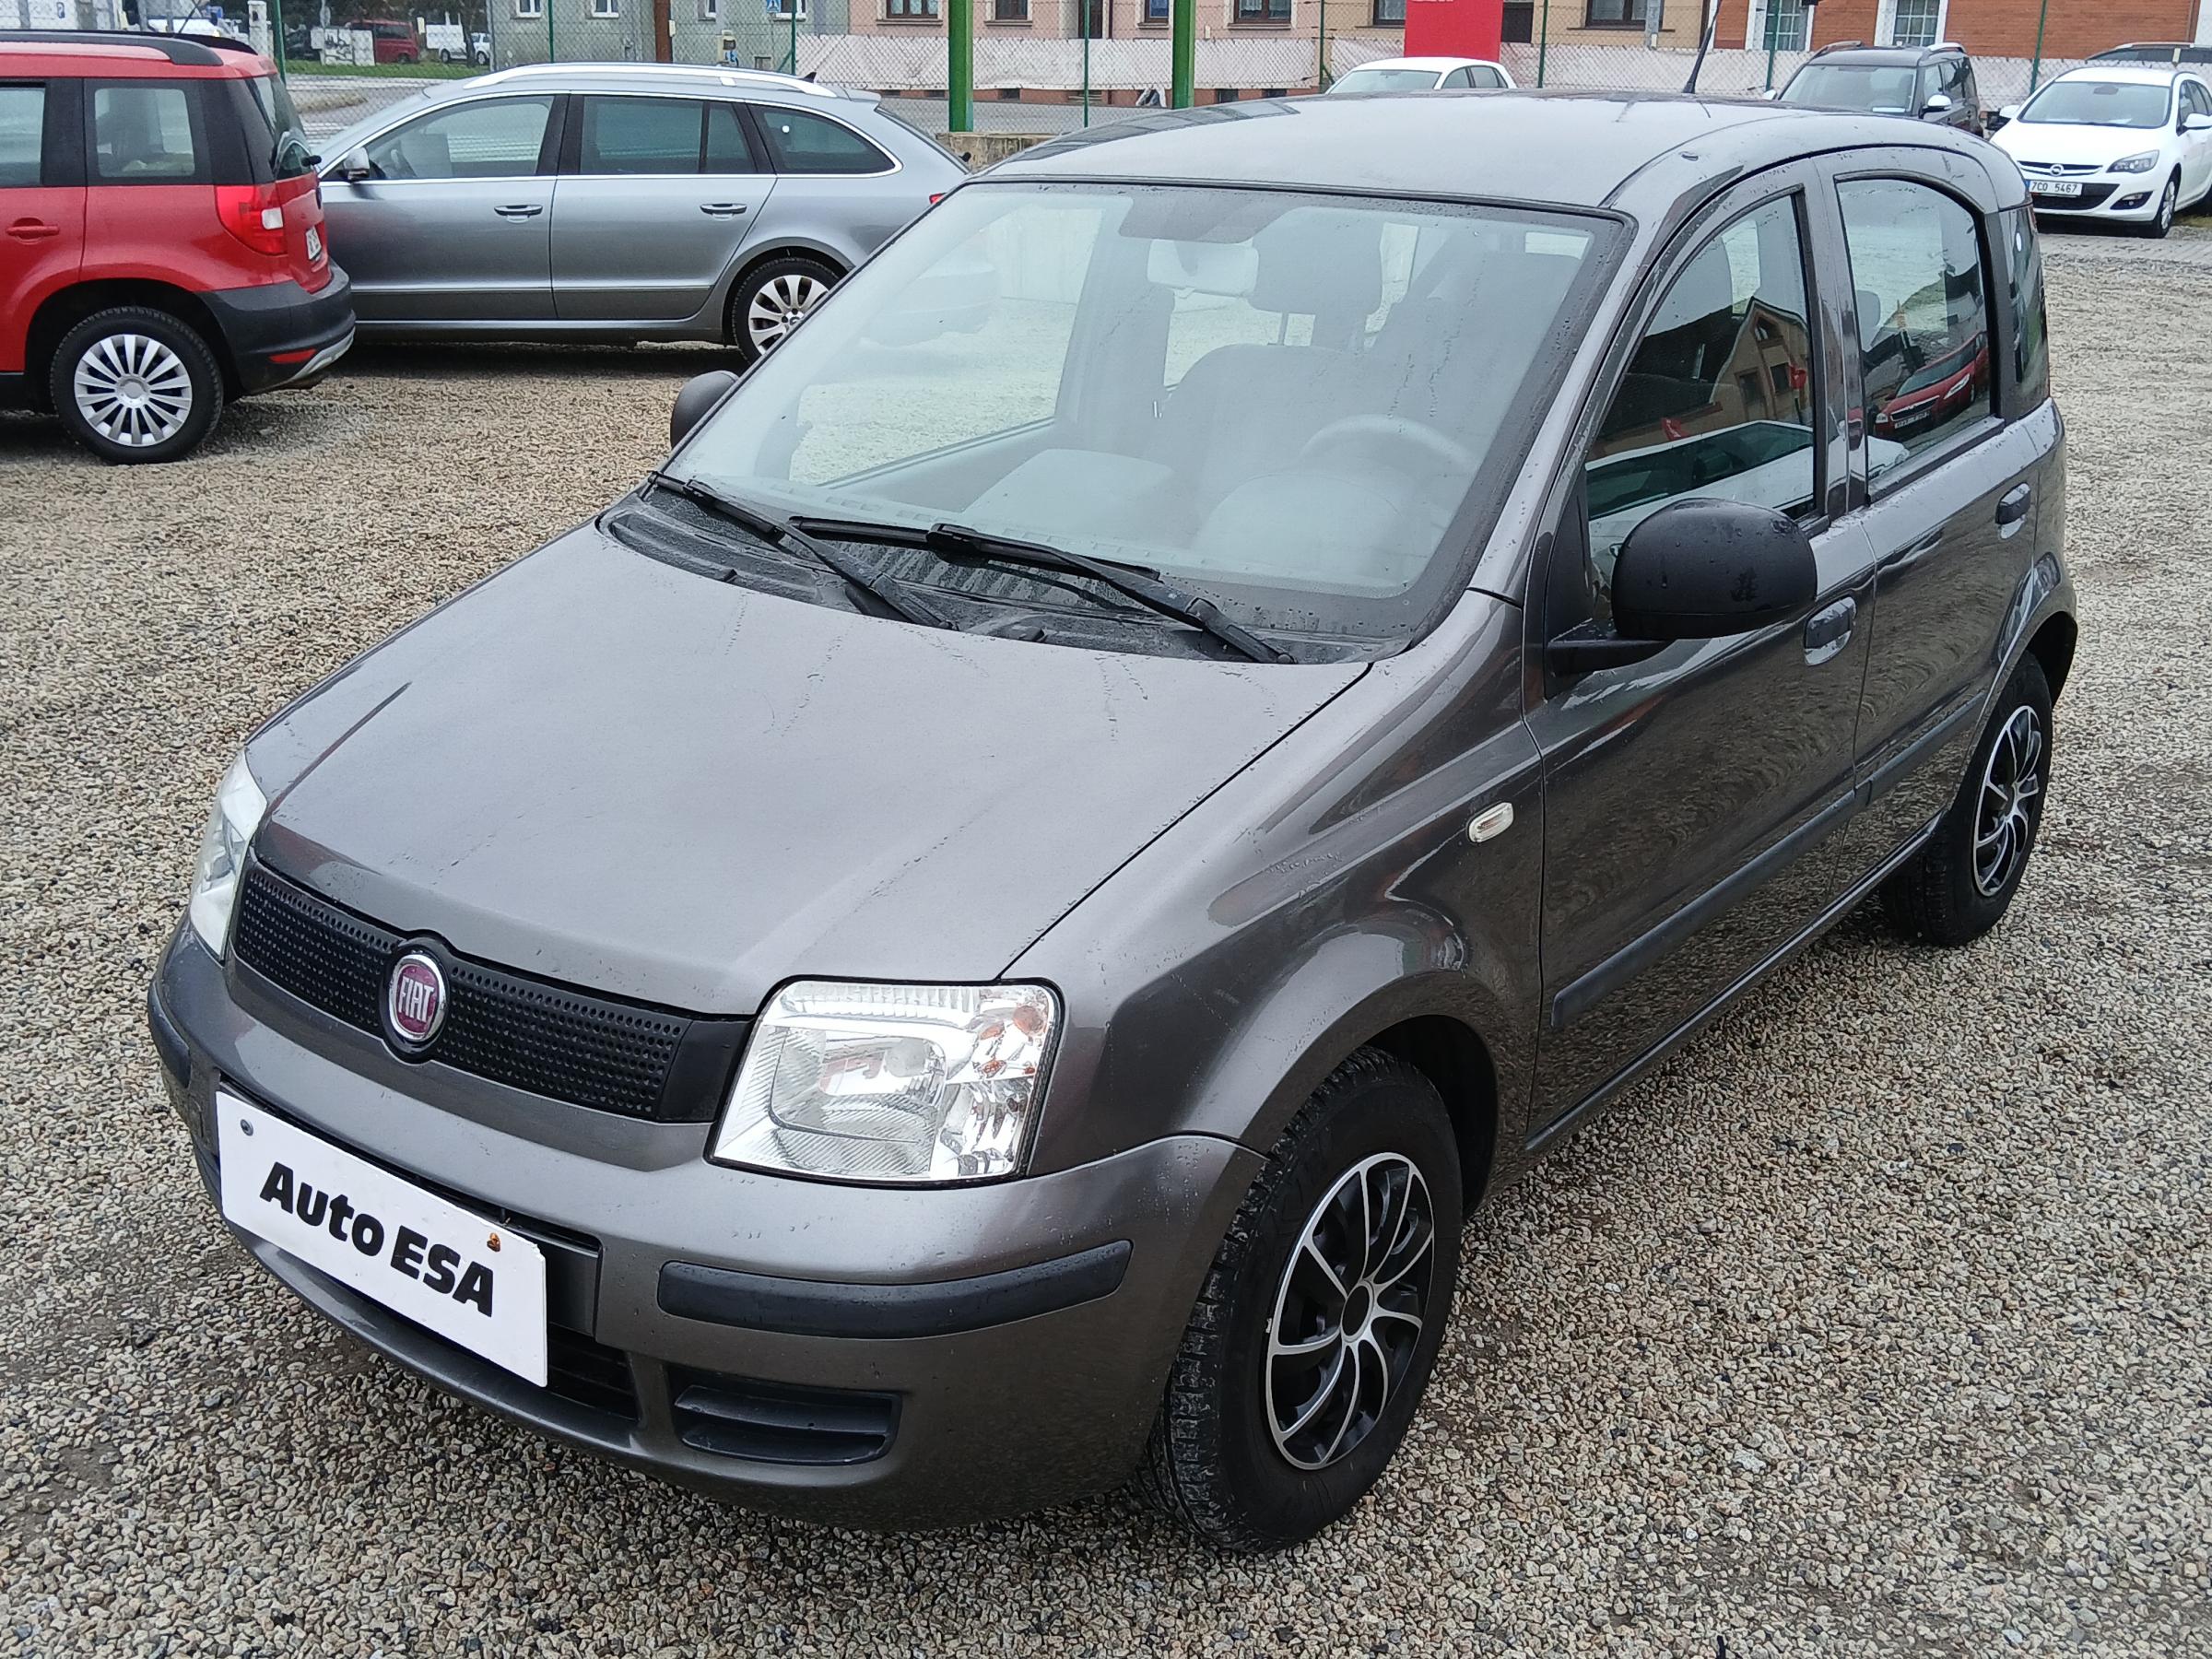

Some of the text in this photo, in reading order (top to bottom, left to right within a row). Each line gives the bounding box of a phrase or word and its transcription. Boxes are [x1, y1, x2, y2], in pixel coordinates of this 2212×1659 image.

[2054, 183, 2077, 193] 5467
[398, 975, 435, 1023] FIAT
[259, 1161, 494, 1318] Auto ESA
